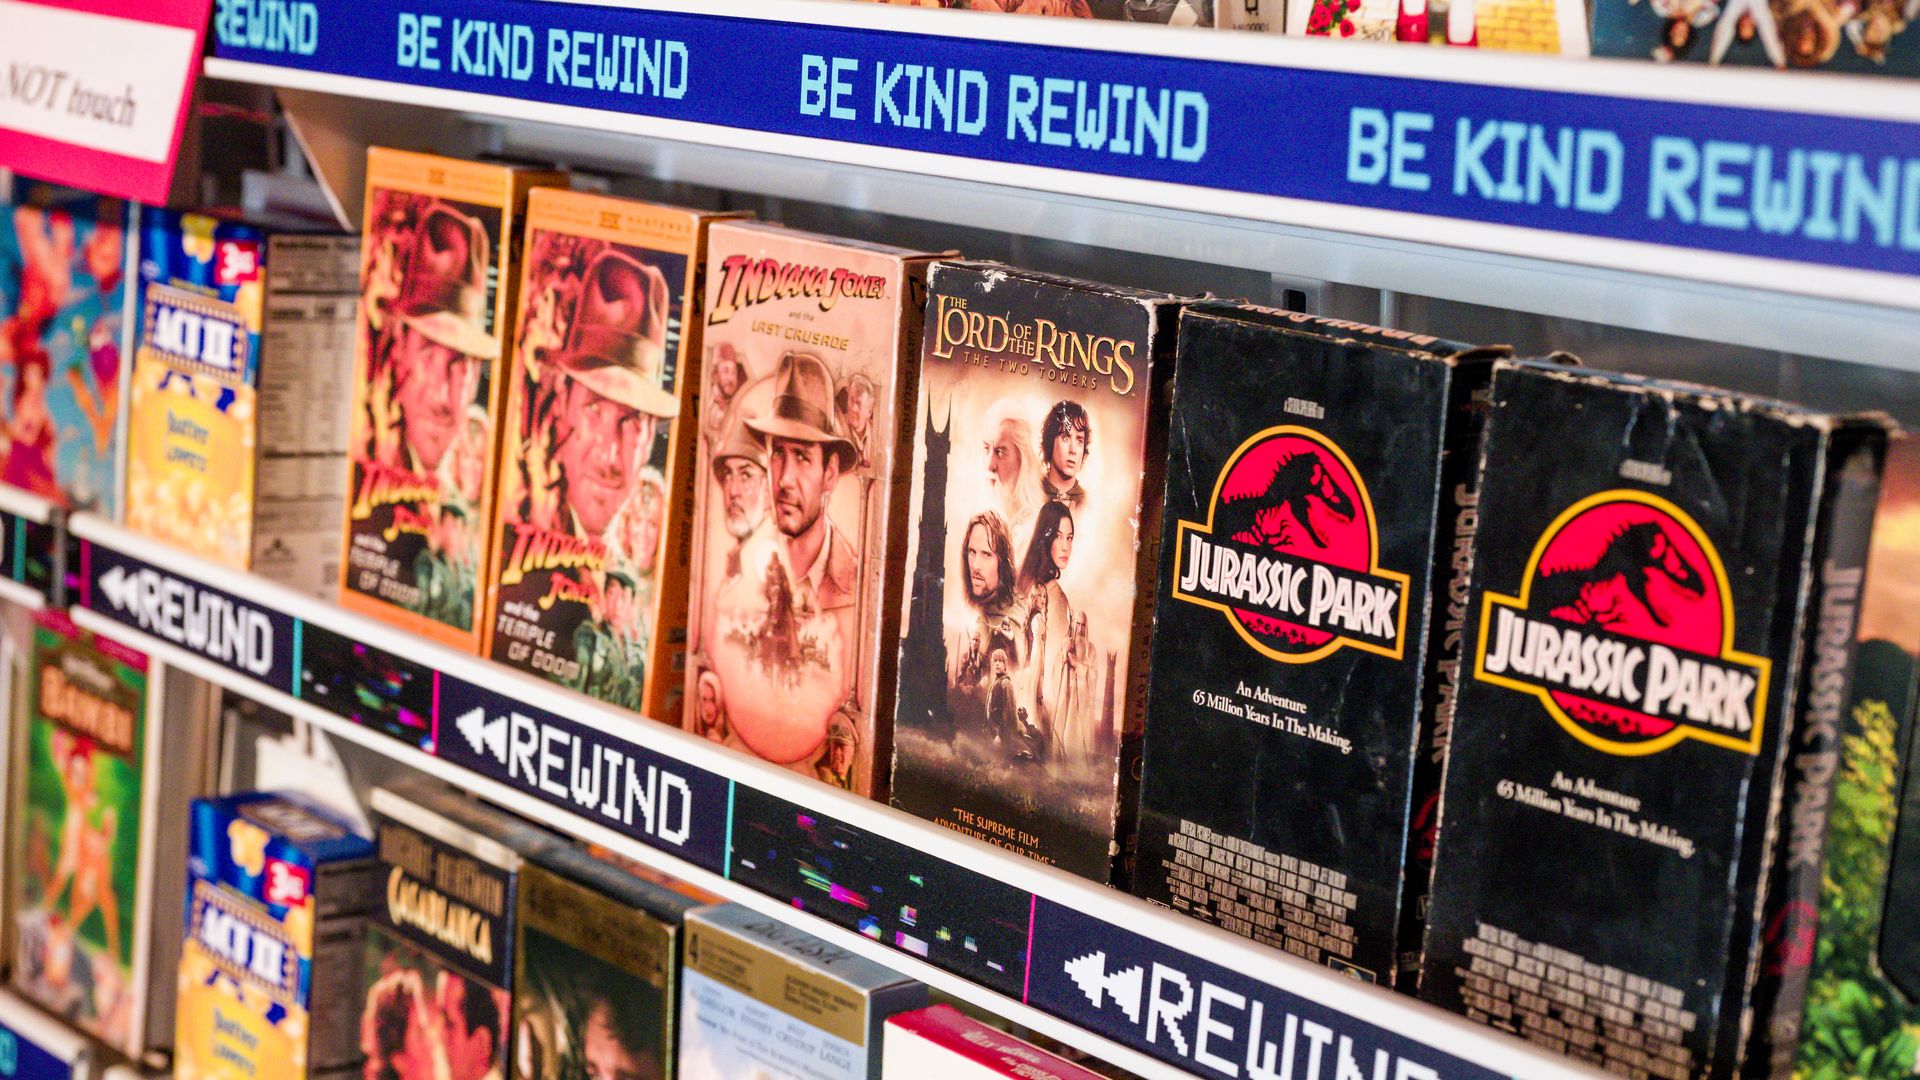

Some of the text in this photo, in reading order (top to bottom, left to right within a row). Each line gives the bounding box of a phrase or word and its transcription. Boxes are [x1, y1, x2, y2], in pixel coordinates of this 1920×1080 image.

[215, 0, 318, 56] REWIND
[398, 12, 689, 100] BE KIND REWIND
[9, 62, 136, 128] NOT touch
[799, 54, 1209, 164] BE KIND REWIND
[1346, 107, 1434, 191] BE
[1452, 117, 1624, 215] KIND
[708, 254, 828, 326] INDIANA
[818, 267, 888, 312] JONES
[949, 297, 968, 309] THE
[751, 319, 851, 351] LAST CRUSADE
[932, 294, 1009, 360] LORD
[1008, 338, 1036, 357] THE
[1013, 323, 1033, 340] OF
[1032, 318, 1136, 395] RINGS
[964, 351, 1097, 390] THE TWO TOWERS
[1181, 533, 1398, 640] JURASSIC PARK
[138, 564, 274, 677] REWIND
[497, 614, 556, 650] TEMPLE
[507, 640, 581, 681] OF DOOM
[1485, 608, 1756, 732] JURASSIC PARK
[1192, 689, 1353, 753] 65 Million Years In The Making.
[1235, 681, 1308, 715] An Adventure
[1788, 558, 1861, 869] JURASSIC PARK
[508, 711, 692, 847] REWIND
[1496, 780, 1514, 801] 65
[1514, 786, 1562, 818] Million
[1563, 799, 1595, 827] Years
[1597, 809, 1612, 830] In
[1612, 812, 1639, 838] The
[1550, 770, 1641, 811] An Adventure
[977, 815, 1017, 841] SUPREME
[1018, 831, 1039, 849] FILM
[989, 836, 1003, 849] OF
